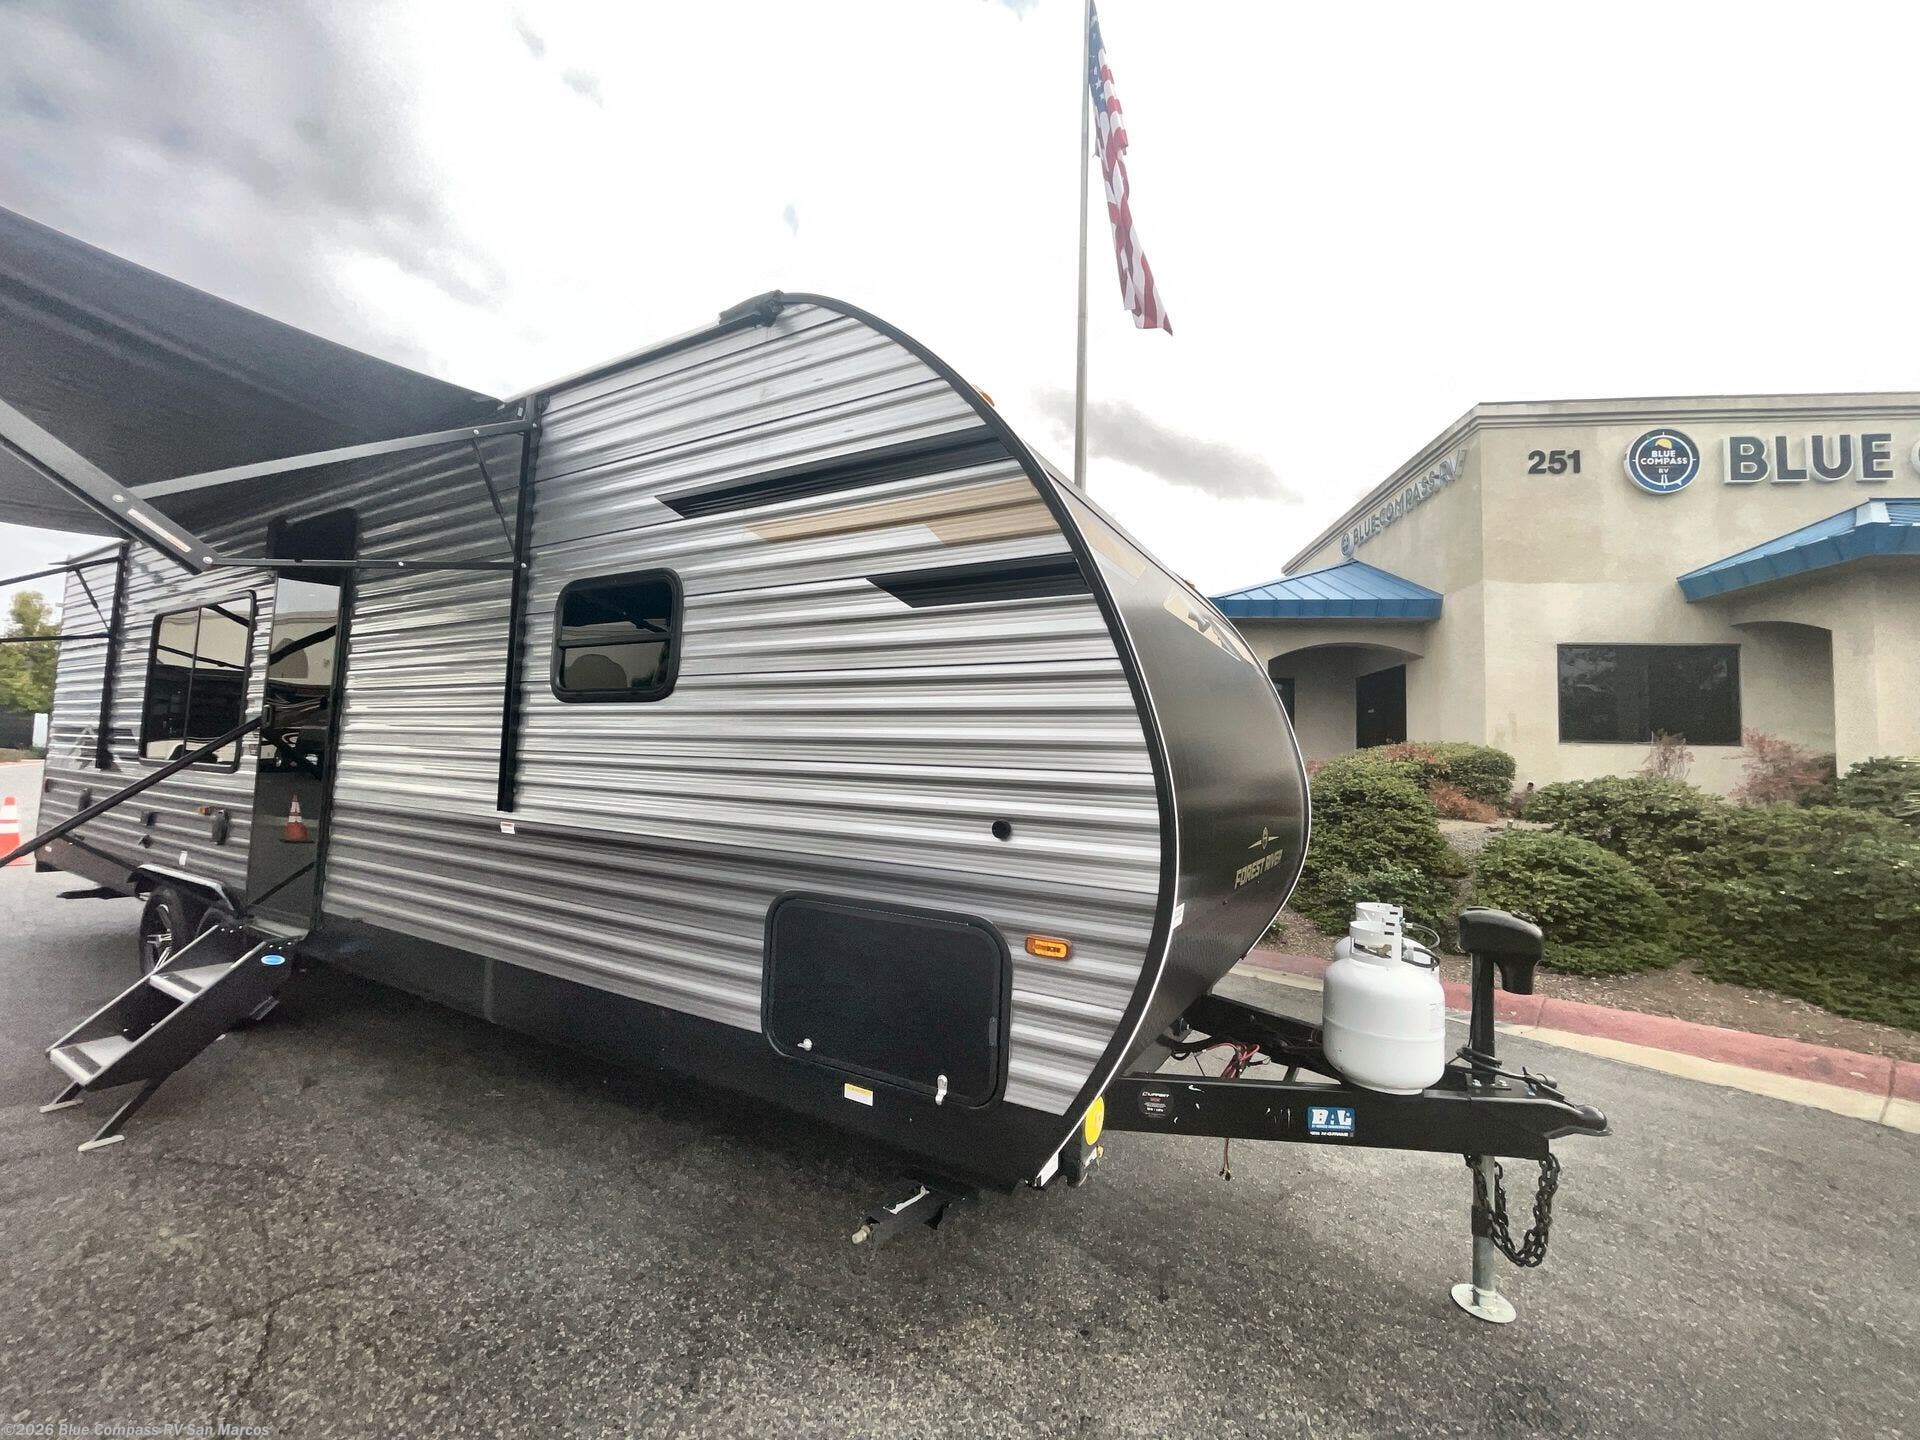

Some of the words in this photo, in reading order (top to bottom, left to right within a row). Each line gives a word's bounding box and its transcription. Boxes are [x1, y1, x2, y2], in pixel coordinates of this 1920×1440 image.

[1528, 449, 1581, 475] 251
[1640, 457, 1688, 465] COMPASS
[1651, 450, 1676, 458] BLUE
[1724, 432, 1895, 483] BLUE
[1353, 514, 1381, 546] BLUE
[1379, 470, 1437, 527] COMPASS
[1234, 856, 1266, 890] FOREST
[1311, 1109, 1352, 1126] BAL
